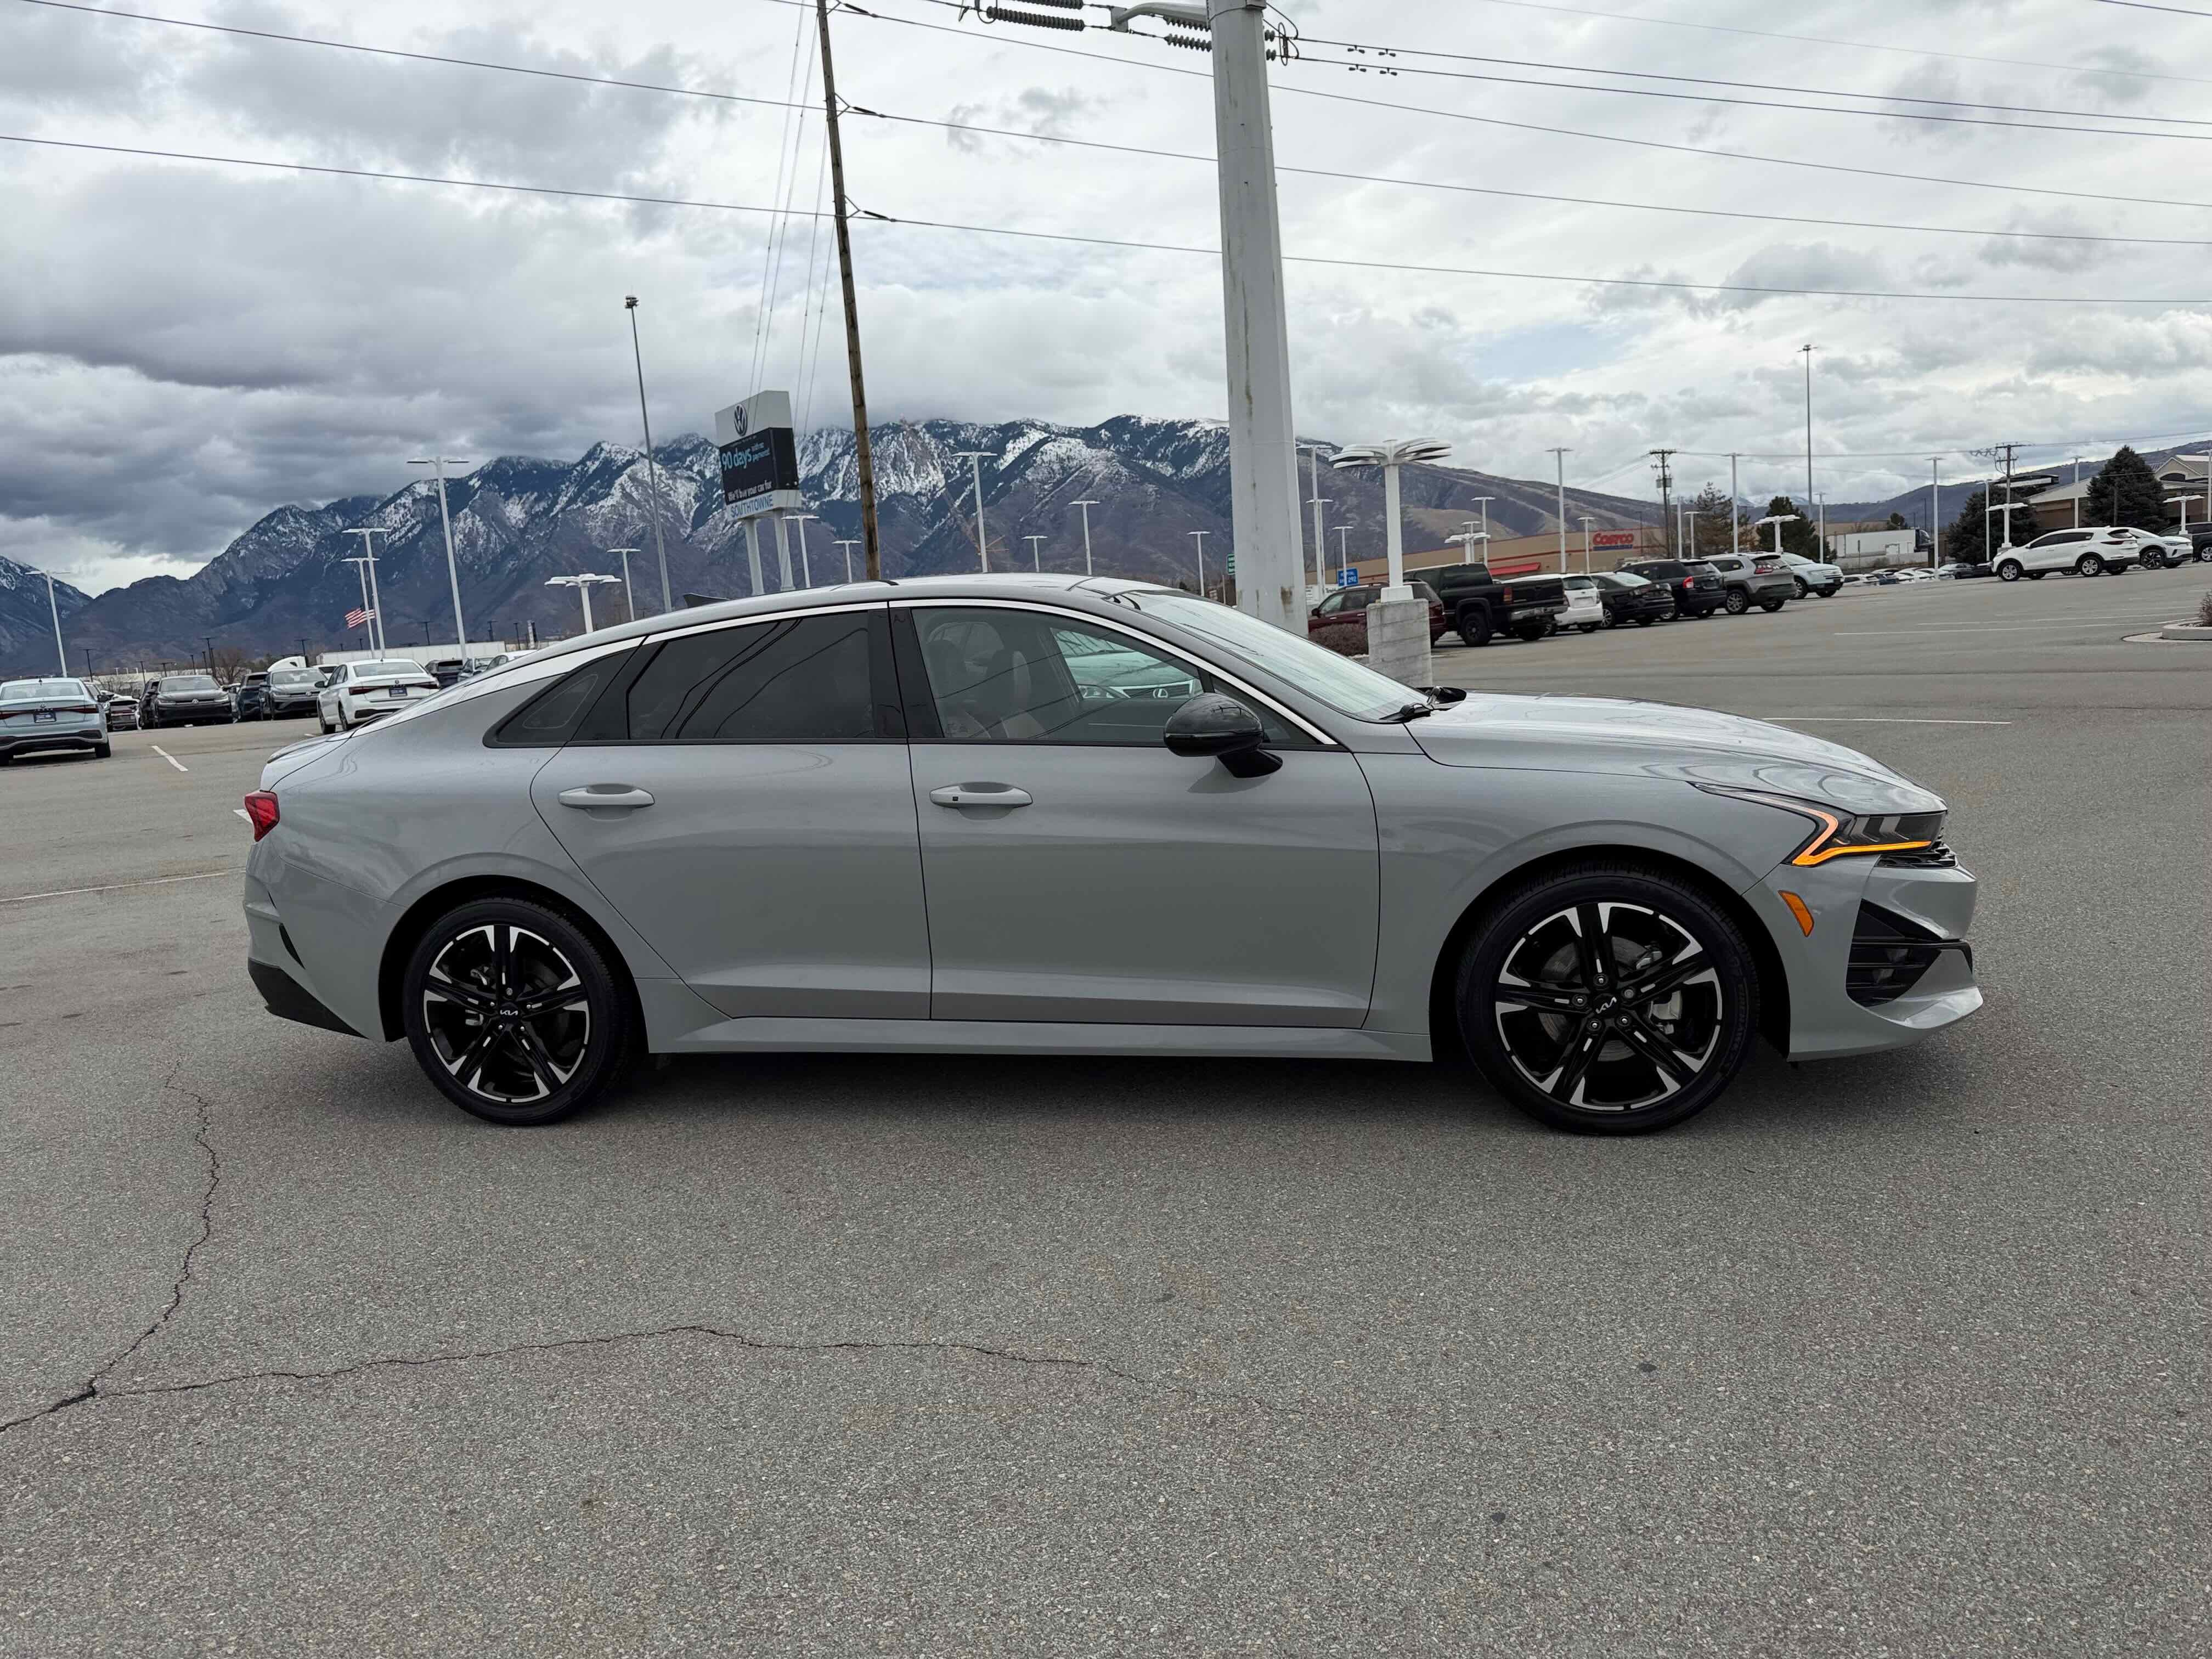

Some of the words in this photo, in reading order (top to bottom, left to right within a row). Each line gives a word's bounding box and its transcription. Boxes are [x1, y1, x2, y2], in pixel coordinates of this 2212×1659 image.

[721, 451, 733, 471] 90
[733, 448, 752, 469] days
[730, 494, 773, 517] SOUTHTOWNE
